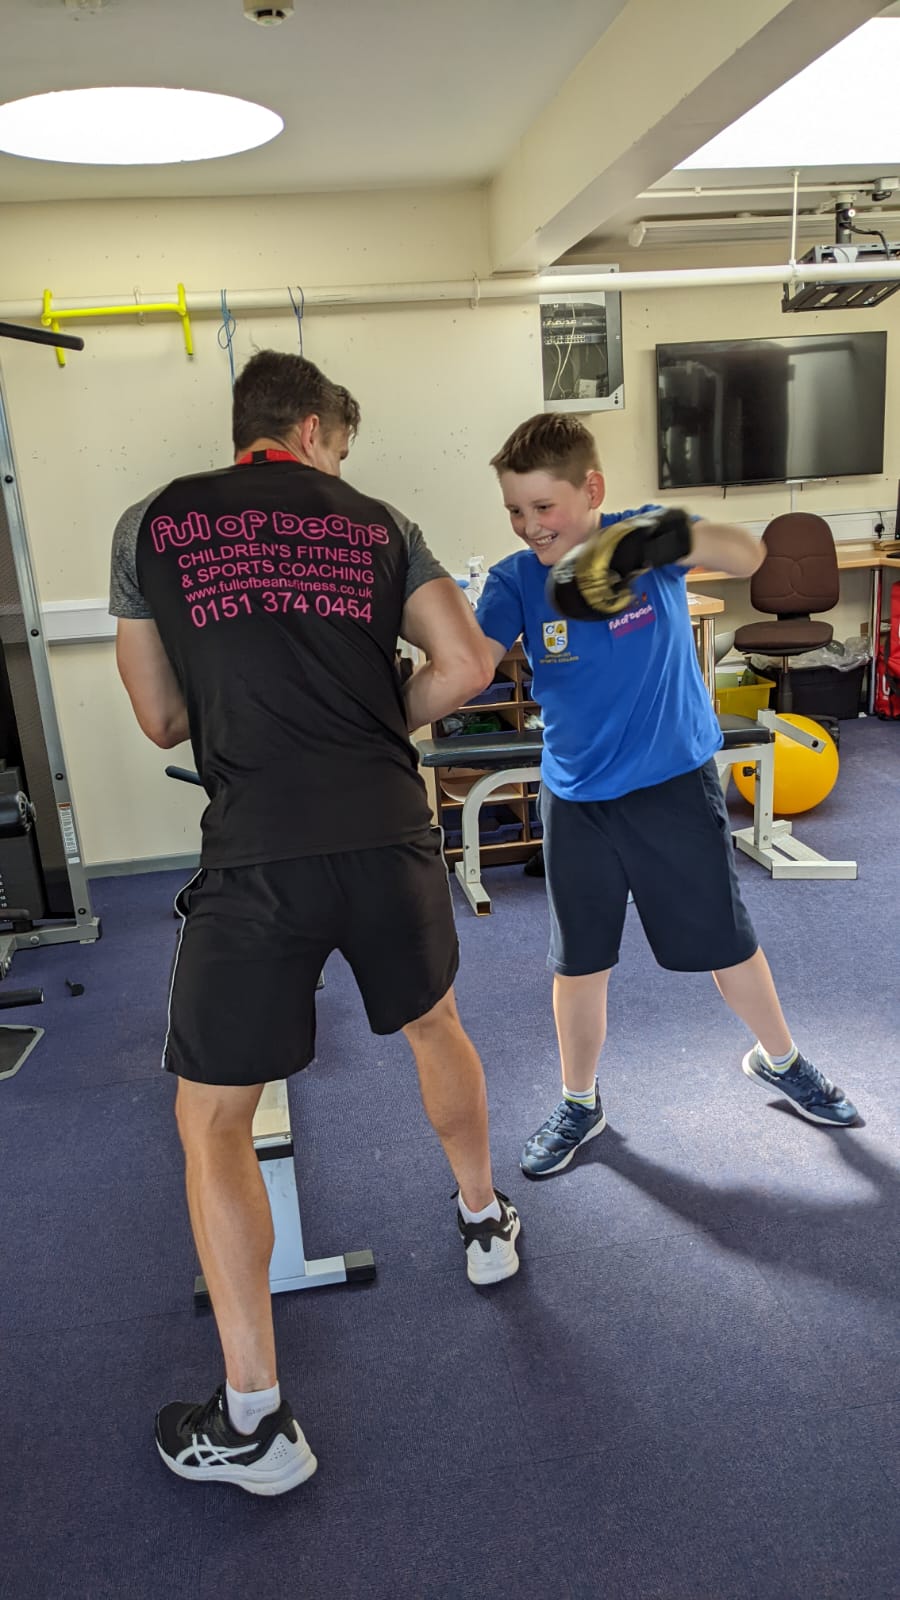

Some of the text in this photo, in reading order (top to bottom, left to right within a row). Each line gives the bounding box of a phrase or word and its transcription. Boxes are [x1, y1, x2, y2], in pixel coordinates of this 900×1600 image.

[151, 512, 211, 552] full
[272, 511, 389, 547] beans
[178, 543, 372, 569] CHILDREN'S FITNESS
[181, 560, 374, 589] & SPORTS COACHING
[191, 591, 372, 628] 0151 374 0454
